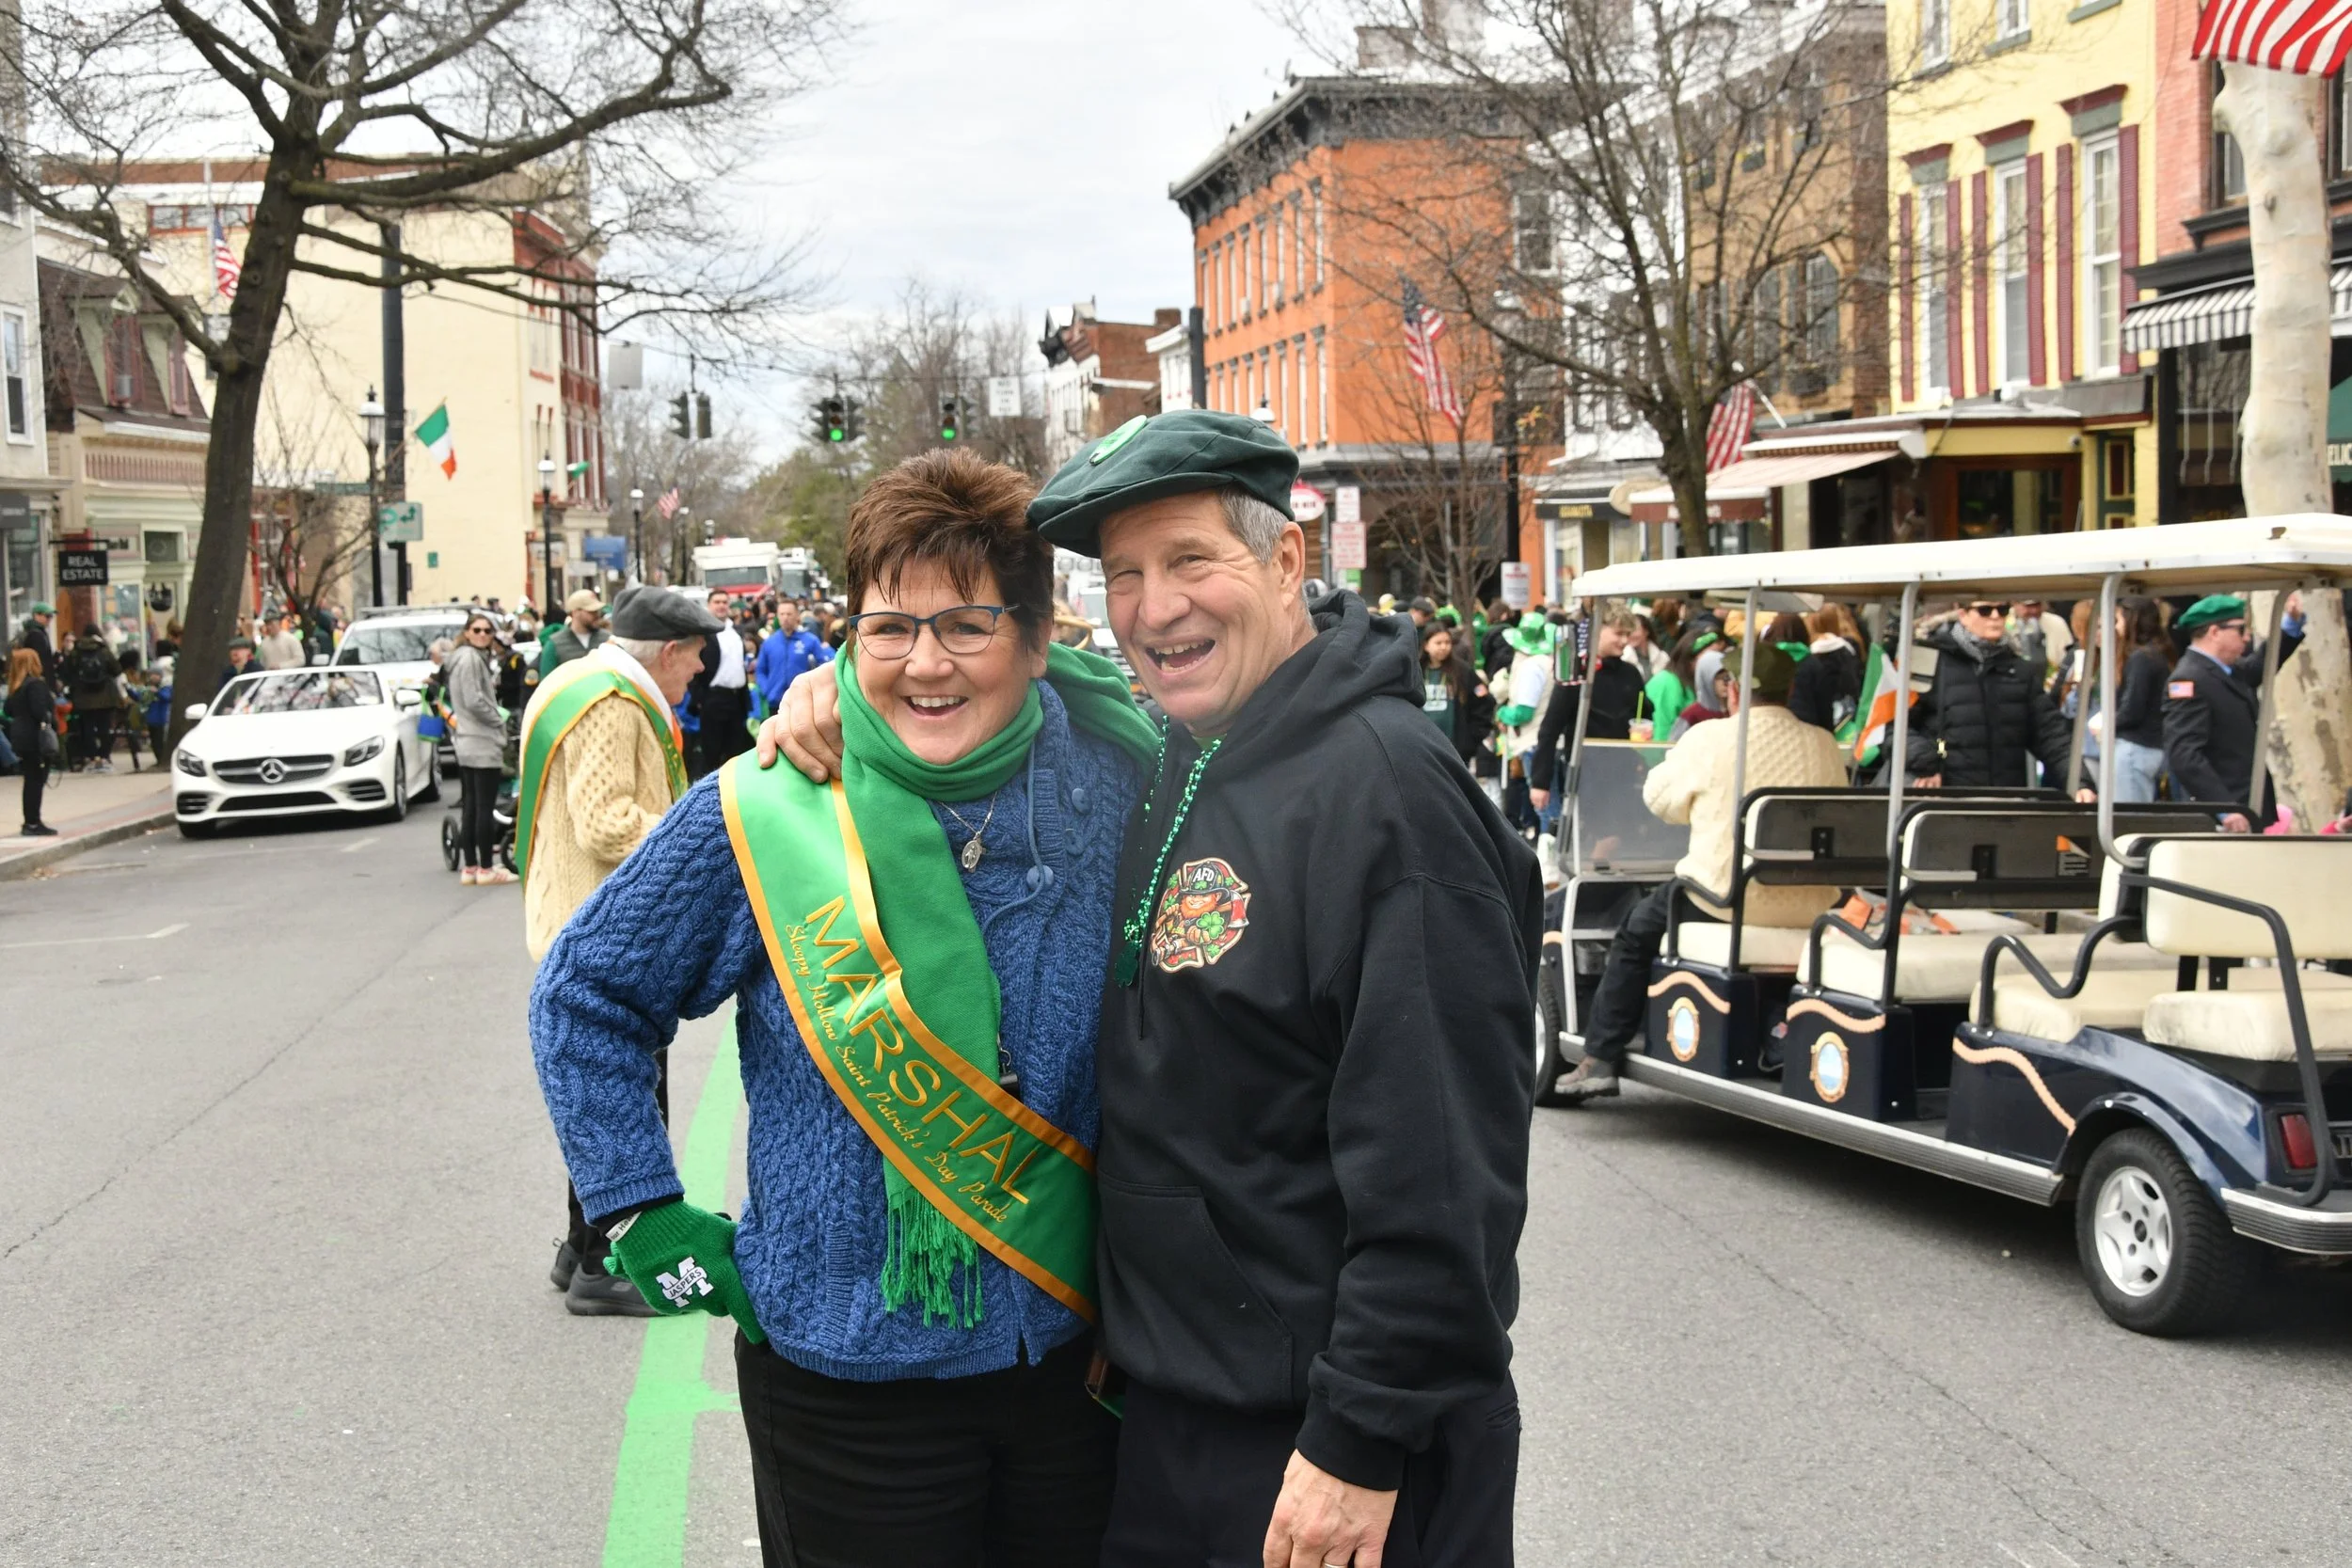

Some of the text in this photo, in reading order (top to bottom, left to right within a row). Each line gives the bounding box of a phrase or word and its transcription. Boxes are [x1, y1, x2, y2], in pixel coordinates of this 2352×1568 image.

[68, 555, 98, 567] REAL
[62, 568, 103, 580] ESTATE
[1192, 867, 1215, 882] AFD
[805, 895, 1040, 1205] MARSHAL
[786, 925, 1009, 1223] Sleepy Hollow Saint Patrick's Day Parade
[669, 1269, 702, 1297] JASPERS
